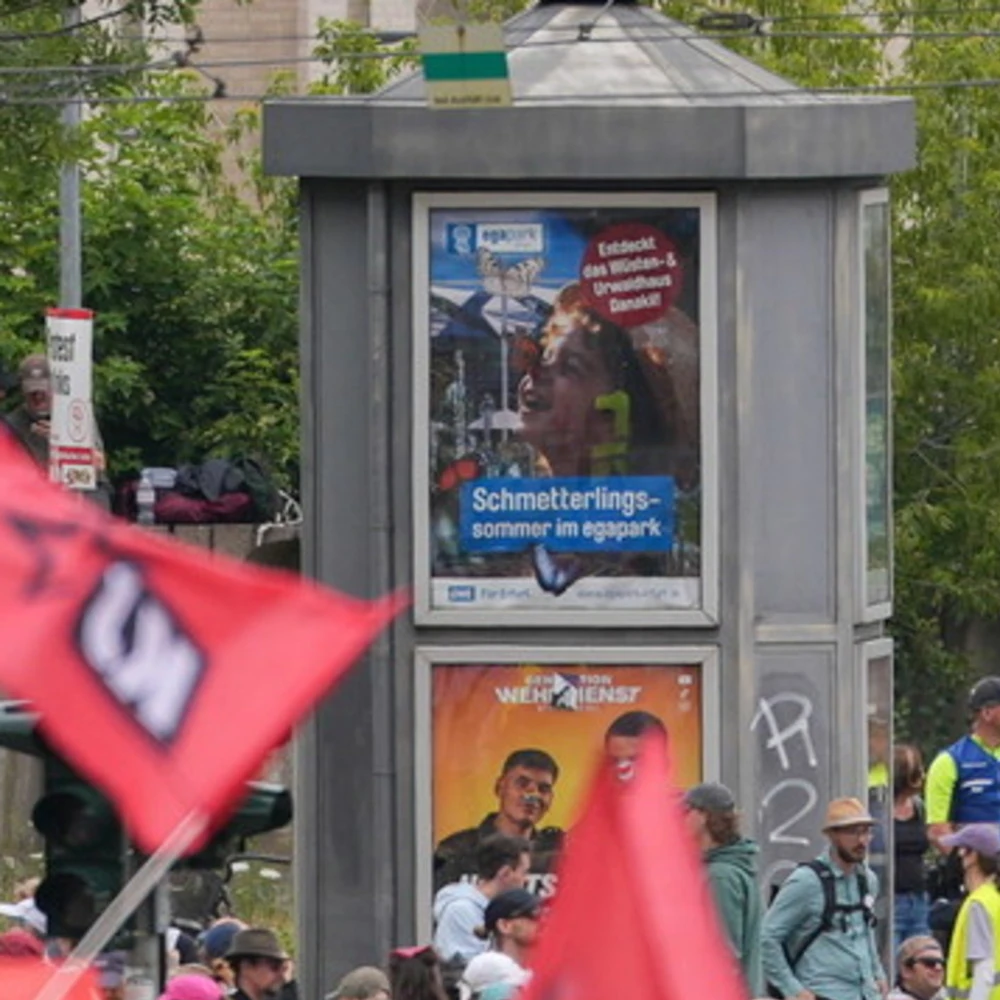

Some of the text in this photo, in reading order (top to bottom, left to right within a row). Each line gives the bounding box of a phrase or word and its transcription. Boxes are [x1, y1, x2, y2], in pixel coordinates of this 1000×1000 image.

[472, 486, 661, 516] Schmetterlings-
[472, 517, 662, 543] sommer im egapark
